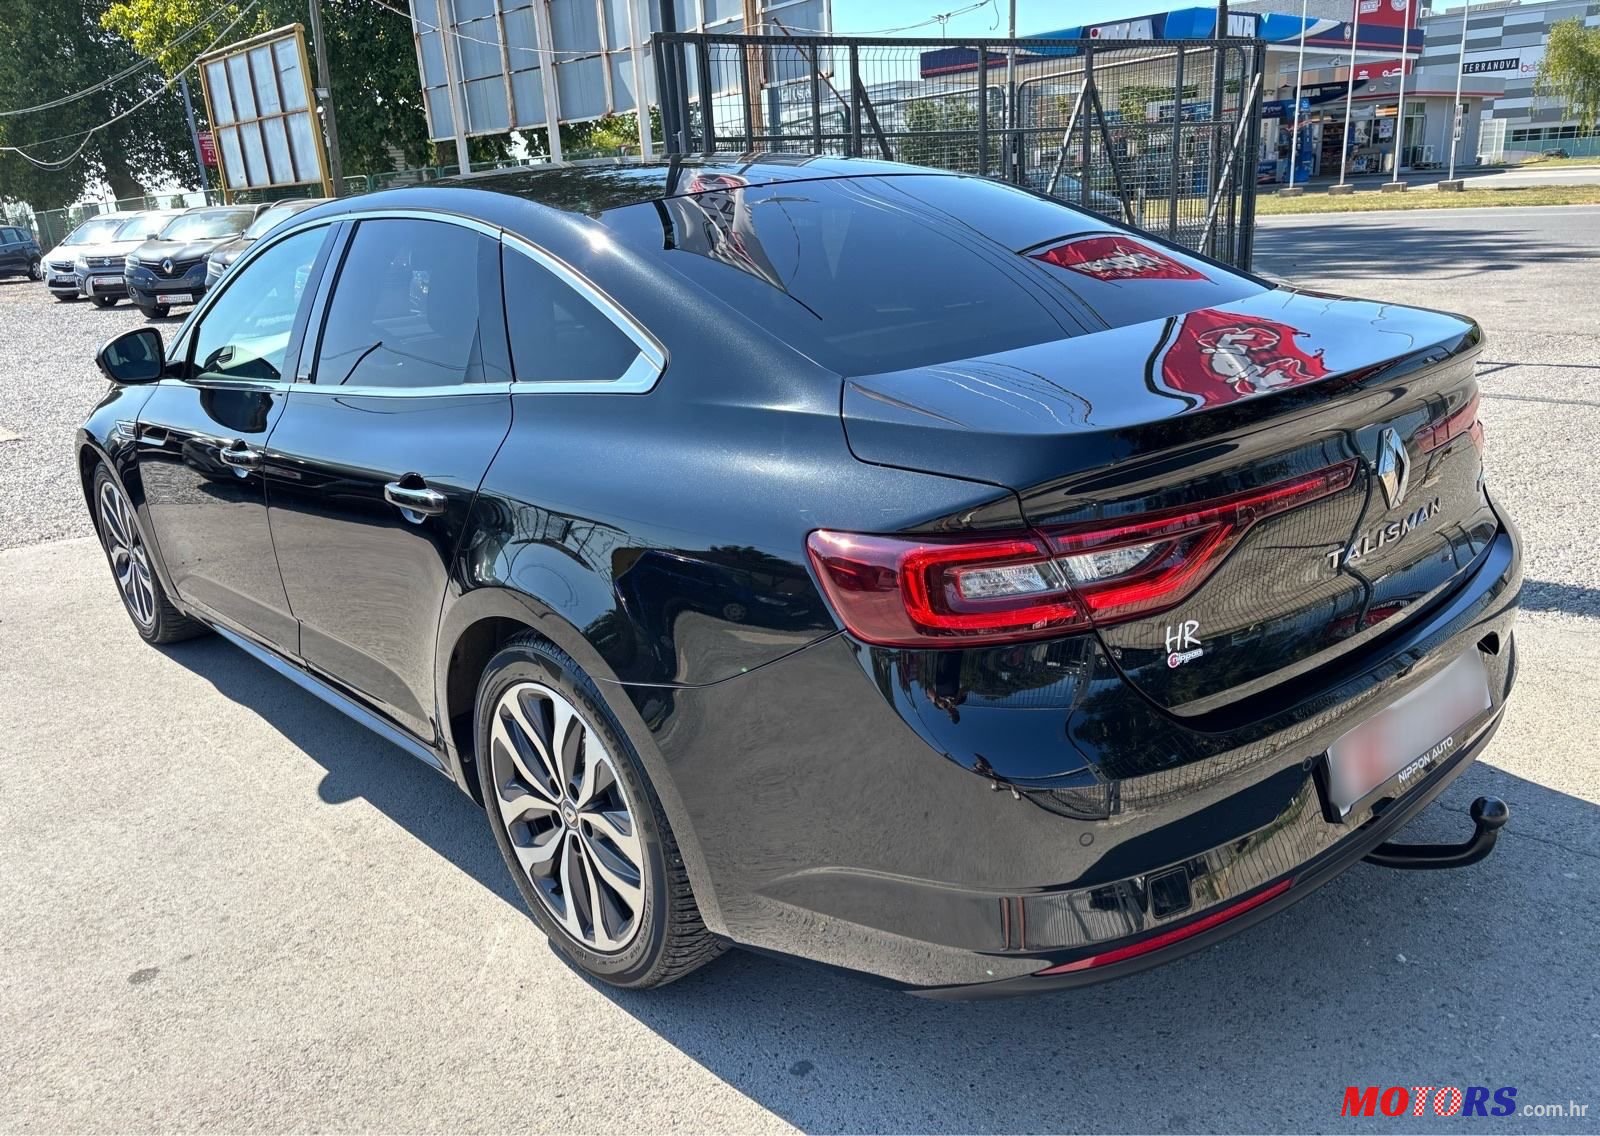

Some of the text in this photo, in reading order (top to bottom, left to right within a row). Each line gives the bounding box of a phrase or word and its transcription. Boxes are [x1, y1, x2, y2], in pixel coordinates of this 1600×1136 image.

[1227, 14, 1256, 37] NA
[1463, 59, 1517, 73] TERRANOVA
[1325, 497, 1441, 569] TALISMAN
[1165, 620, 1202, 654] HR
[1398, 736, 1453, 784] NIPPON AUTO
